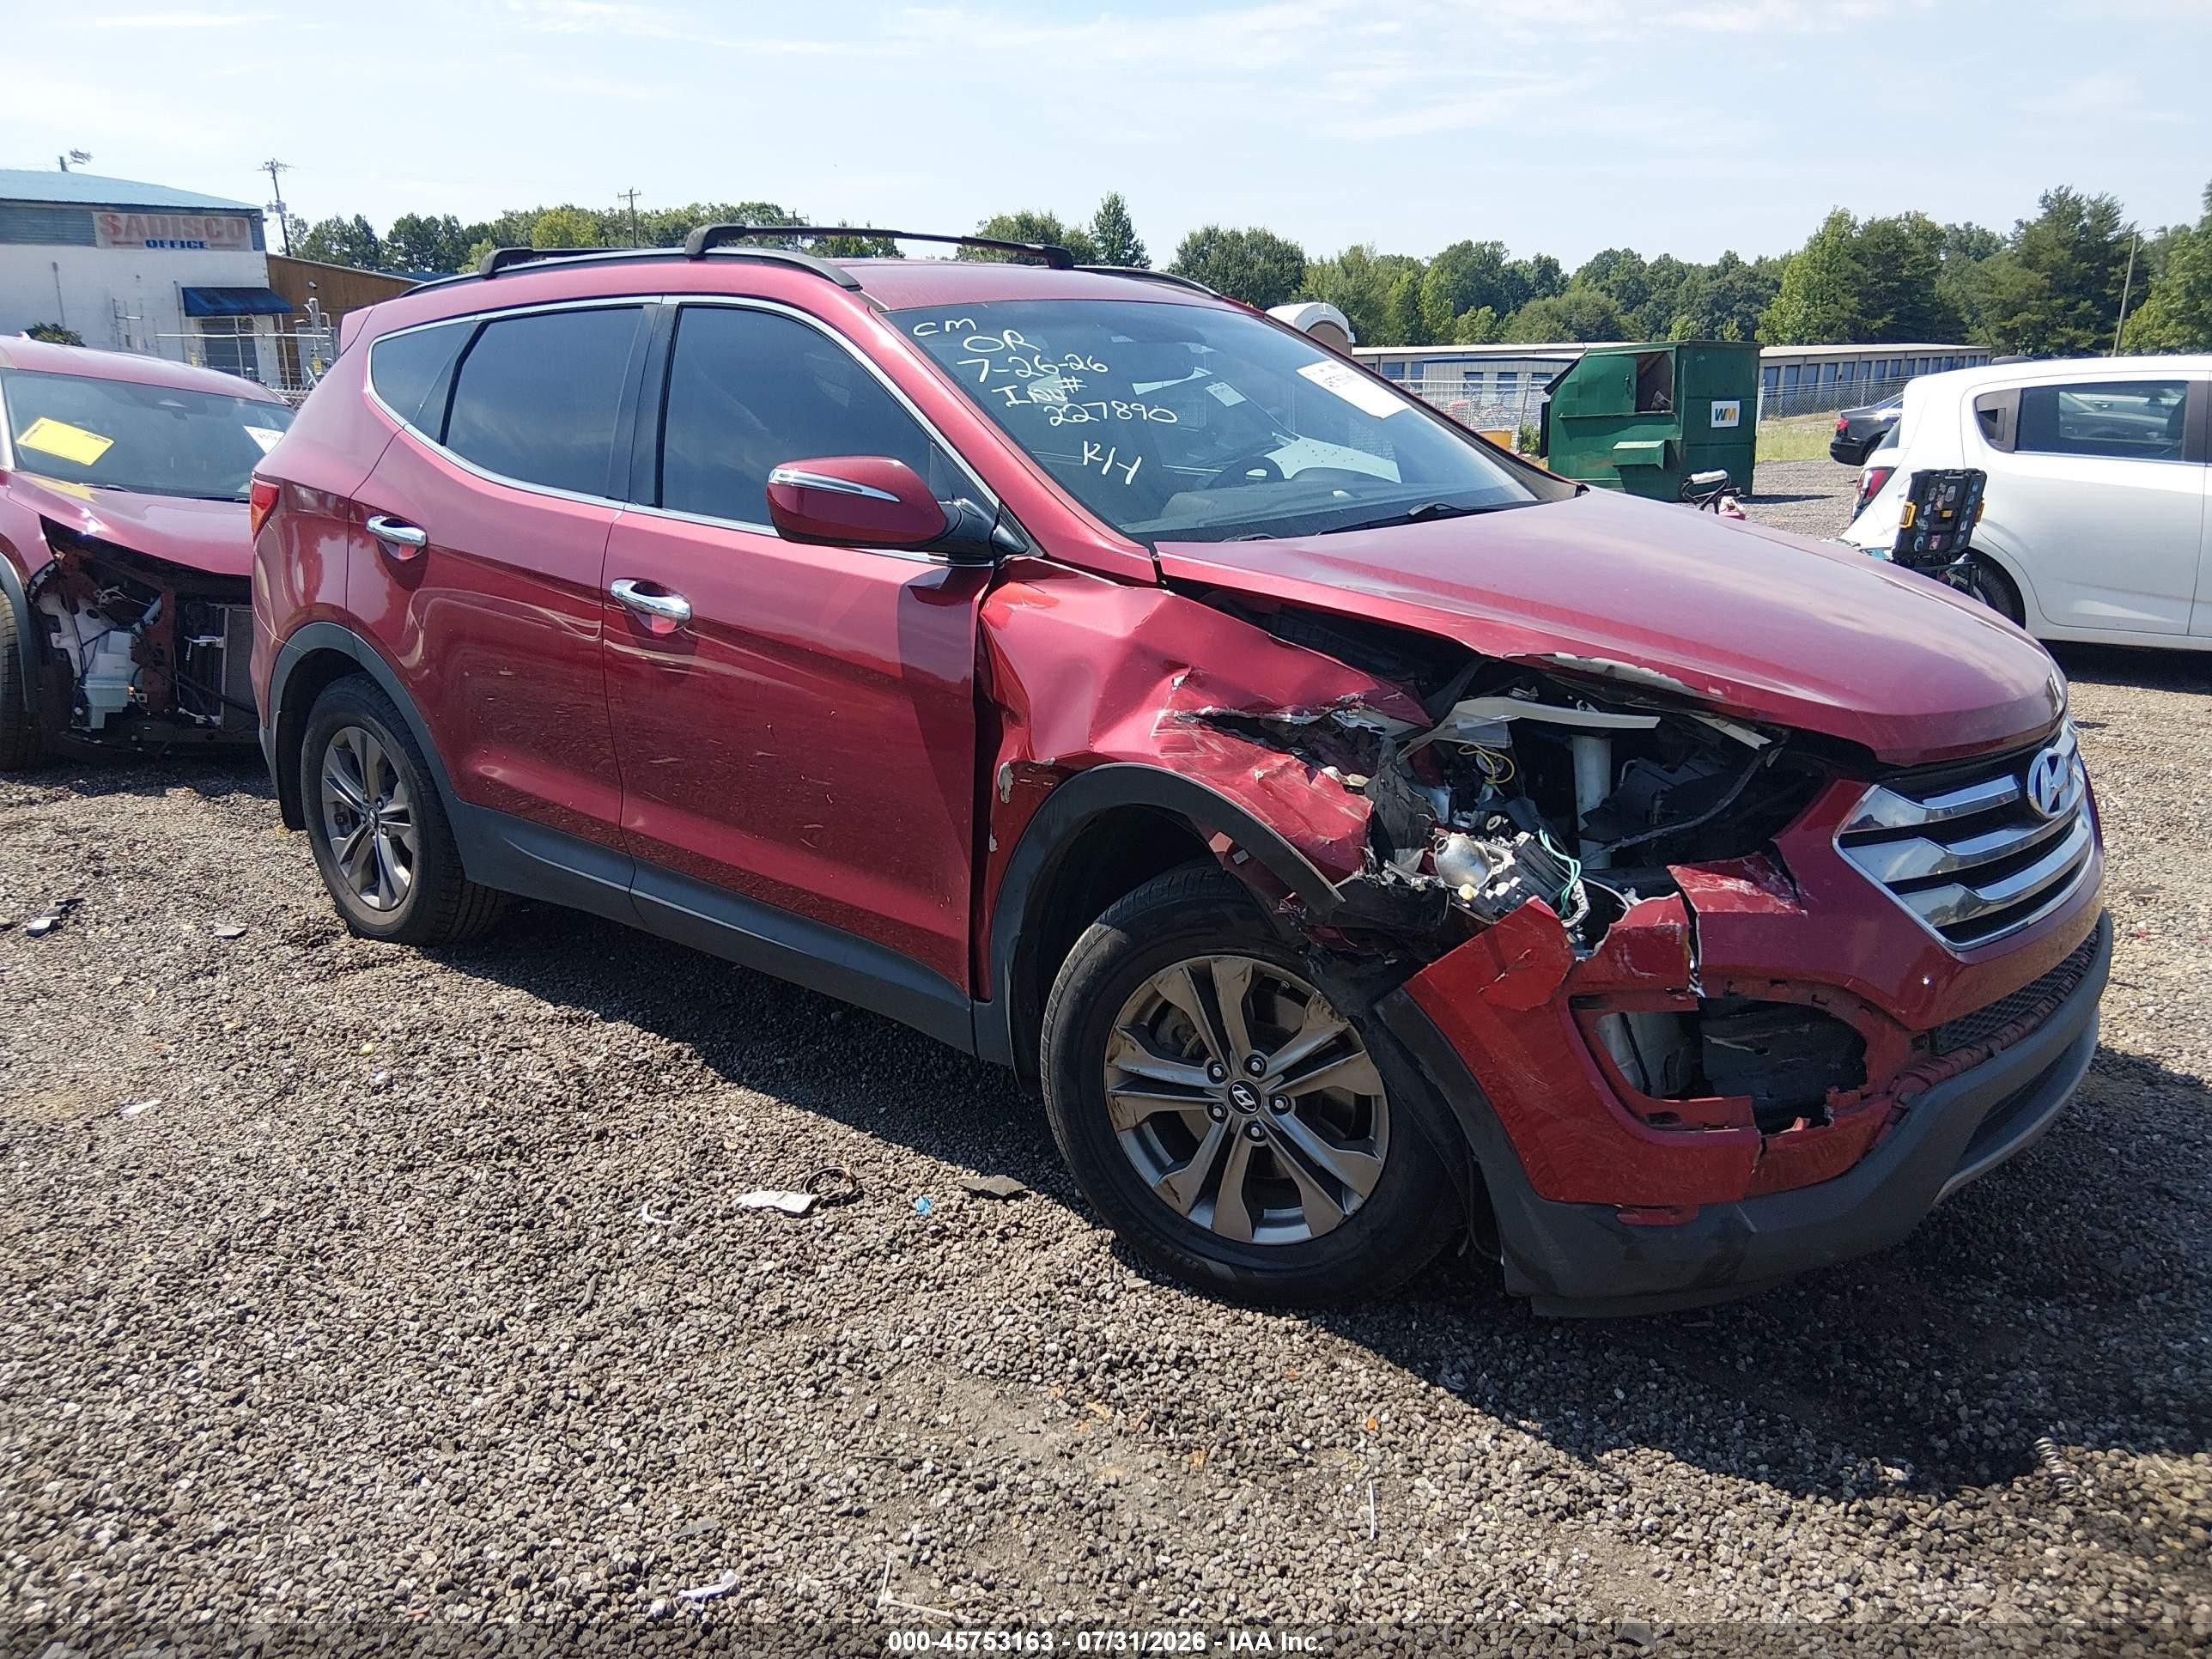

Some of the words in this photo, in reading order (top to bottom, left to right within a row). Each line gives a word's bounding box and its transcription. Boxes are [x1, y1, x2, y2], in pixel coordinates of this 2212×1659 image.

[98, 214, 247, 240] SADISCO
[145, 238, 208, 249] OFFICE
[963, 329, 1042, 353] OR
[957, 353, 1109, 383] 7-26-26
[1043, 400, 1178, 427] 227890
[1715, 407, 1737, 422] WM
